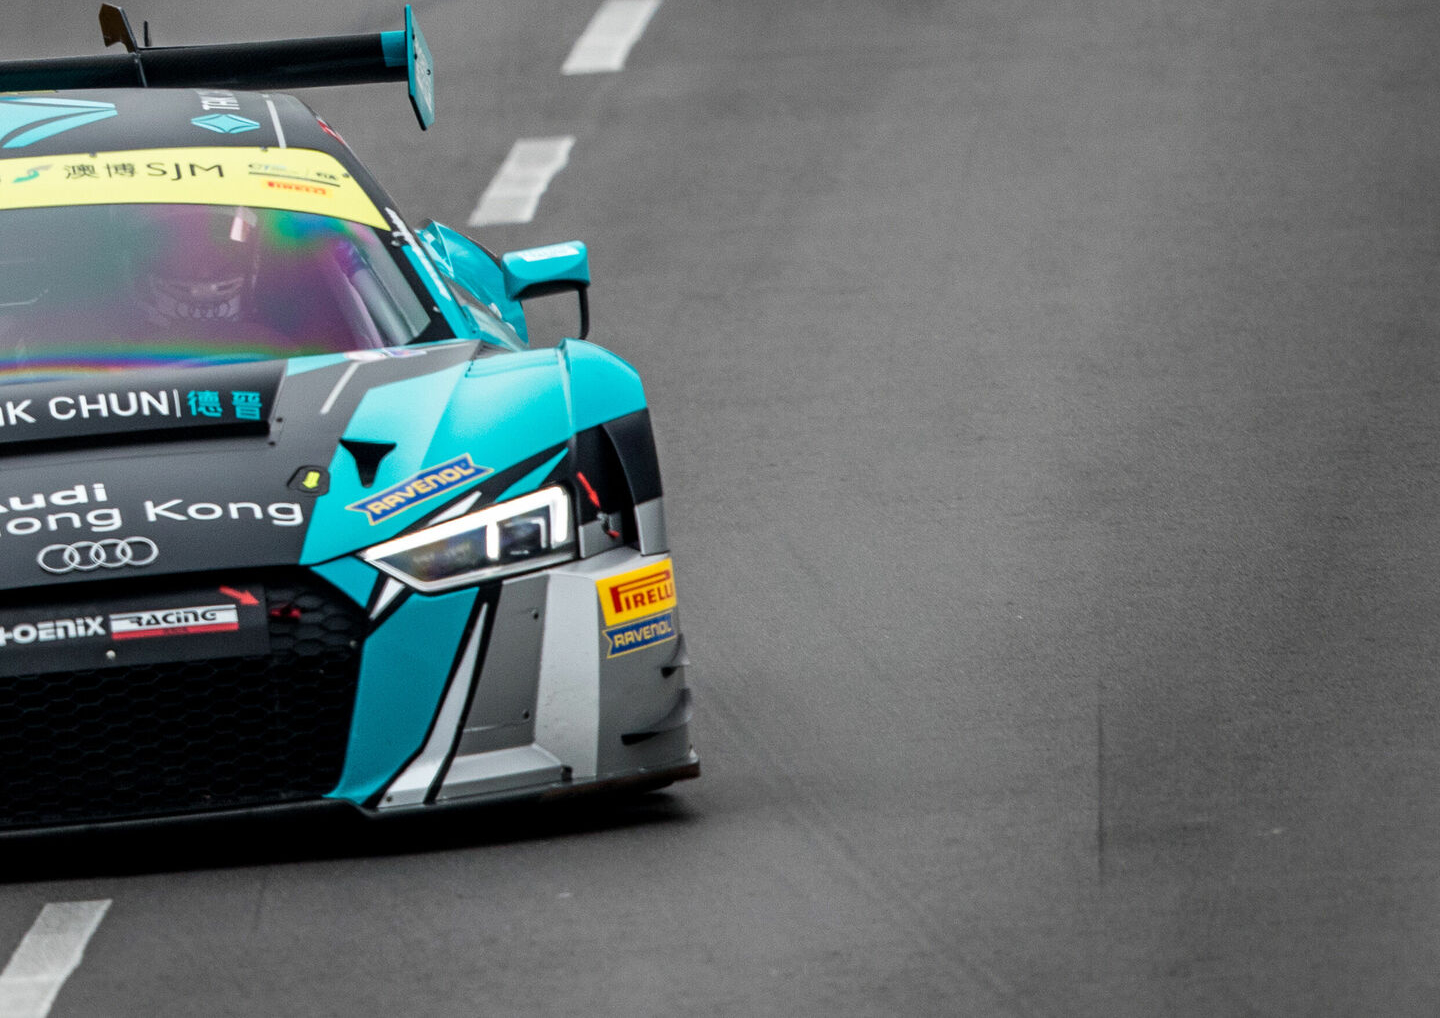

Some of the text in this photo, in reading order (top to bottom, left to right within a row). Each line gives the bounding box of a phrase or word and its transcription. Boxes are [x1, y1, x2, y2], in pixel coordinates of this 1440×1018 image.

[145, 161, 225, 181] SJM
[48, 389, 172, 422] CHUN
[368, 463, 476, 516] RAVENOL
[144, 498, 304, 527] Kong
[610, 569, 674, 614] PIRELLI
[613, 620, 672, 648] RAVENOL
